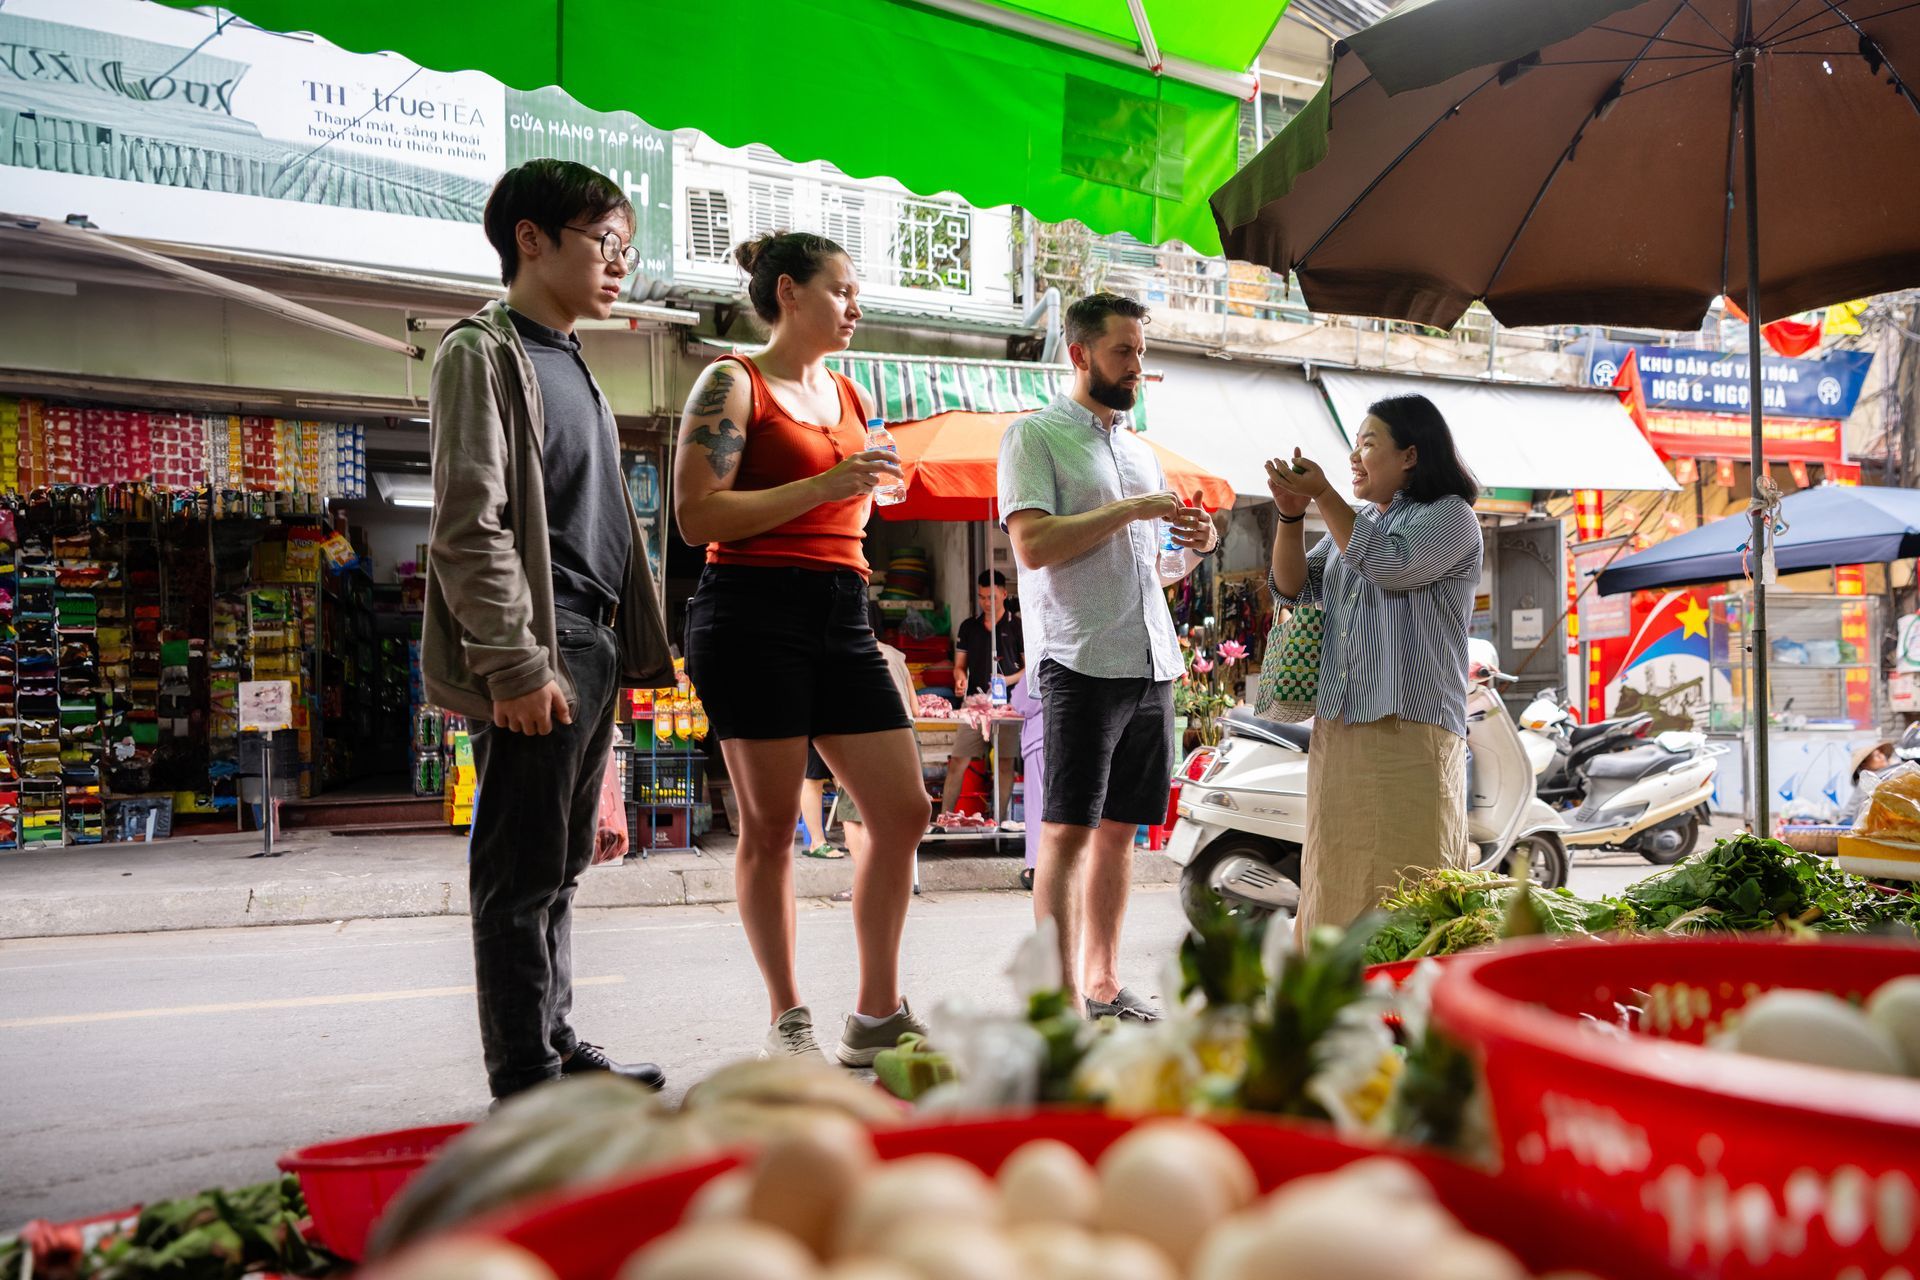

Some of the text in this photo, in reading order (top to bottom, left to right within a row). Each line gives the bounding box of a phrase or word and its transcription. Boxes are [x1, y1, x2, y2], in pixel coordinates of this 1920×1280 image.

[302, 80, 345, 106] TH
[314, 110, 361, 128] Thanh
[510, 112, 545, 134] CỬA
[548, 120, 594, 141] HÀNG
[598, 128, 629, 147] TẠP
[308, 124, 345, 141] hoàn
[350, 131, 383, 147] toàn
[407, 139, 443, 155] thiên
[447, 146, 487, 161] nhiên
[1639, 355, 1673, 373] KHU
[1675, 356, 1708, 376] DÂN
[1767, 364, 1799, 383] HÓA
[1713, 383, 1749, 409] NGỌ
[1763, 384, 1786, 408] HÀ
